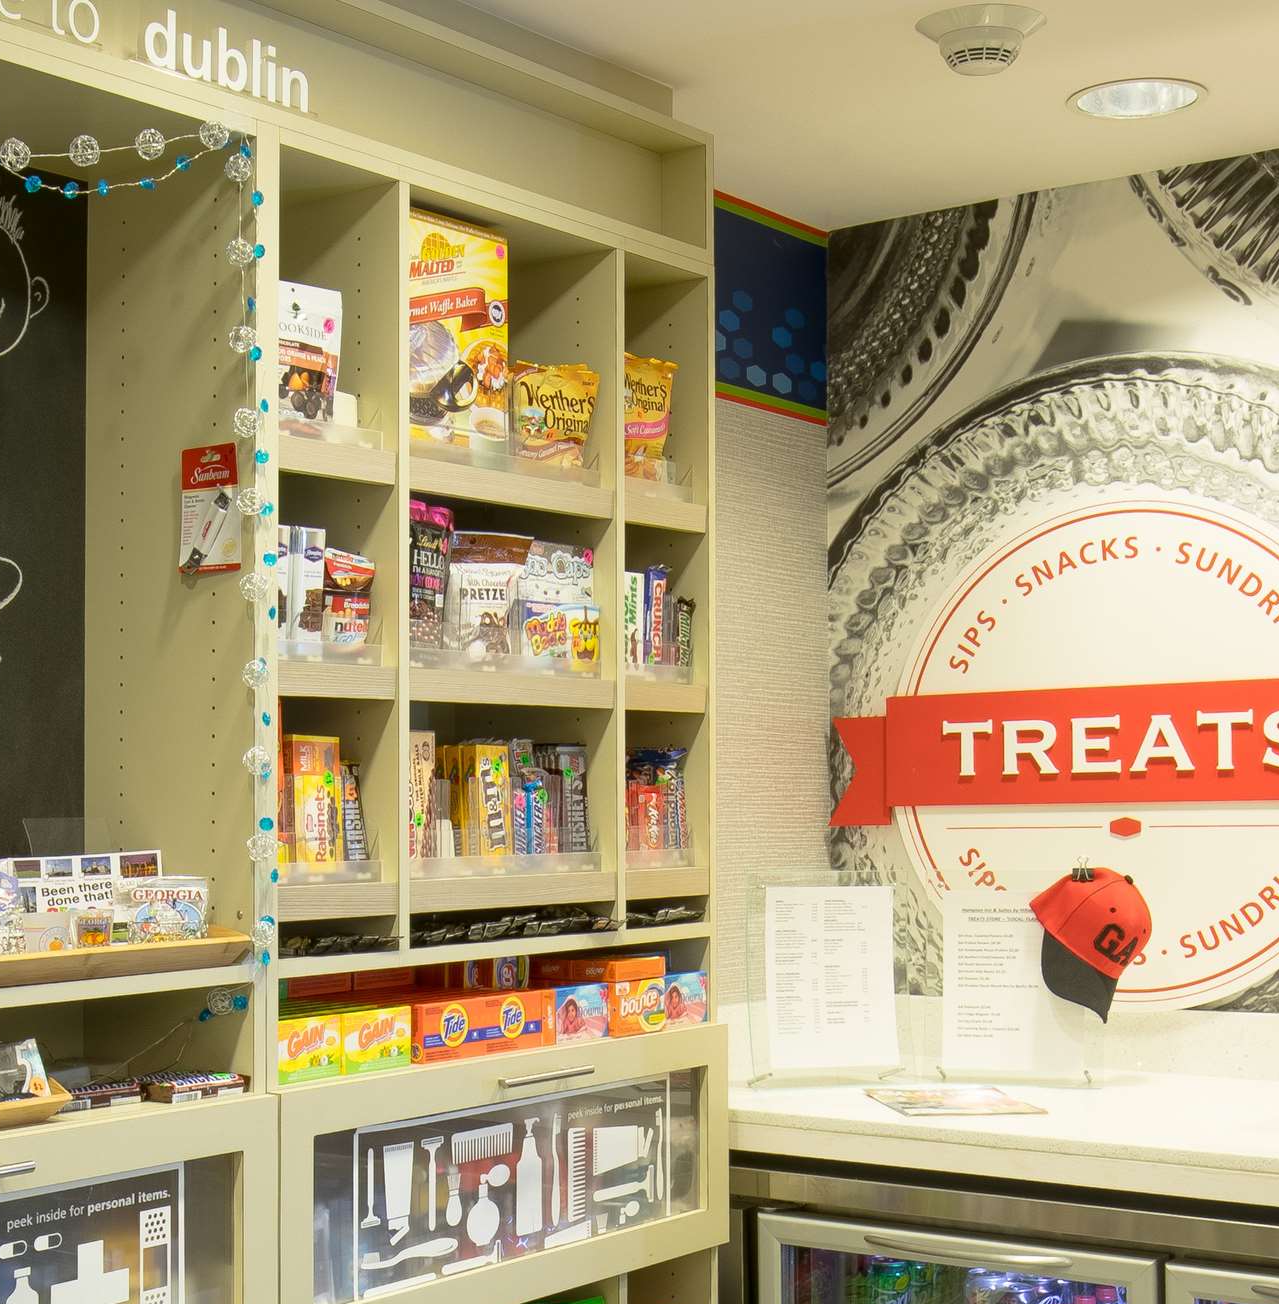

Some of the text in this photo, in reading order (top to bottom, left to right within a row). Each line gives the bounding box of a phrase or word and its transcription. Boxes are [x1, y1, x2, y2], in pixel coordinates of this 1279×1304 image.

[144, 9, 309, 113] dublin
[409, 260, 454, 278] MALTED
[430, 296, 477, 315] Waffle Baker
[520, 381, 596, 414] Werther's
[949, 608, 997, 675] SIPS
[1014, 536, 1141, 598] SNACKS
[959, 846, 1007, 892] SIP
[40, 879, 113, 898] Been there
[47, 889, 114, 907] done that!
[132, 888, 204, 903] GEORGIA
[1093, 923, 1139, 966] GA
[500, 1005, 523, 1030] Tide
[620, 988, 659, 1018] bounce
[287, 1024, 326, 1058] GAIN
[359, 1017, 397, 1049] GAIN
[443, 1012, 467, 1040] Tide
[7, 1189, 171, 1232] peek inside for personal items.
